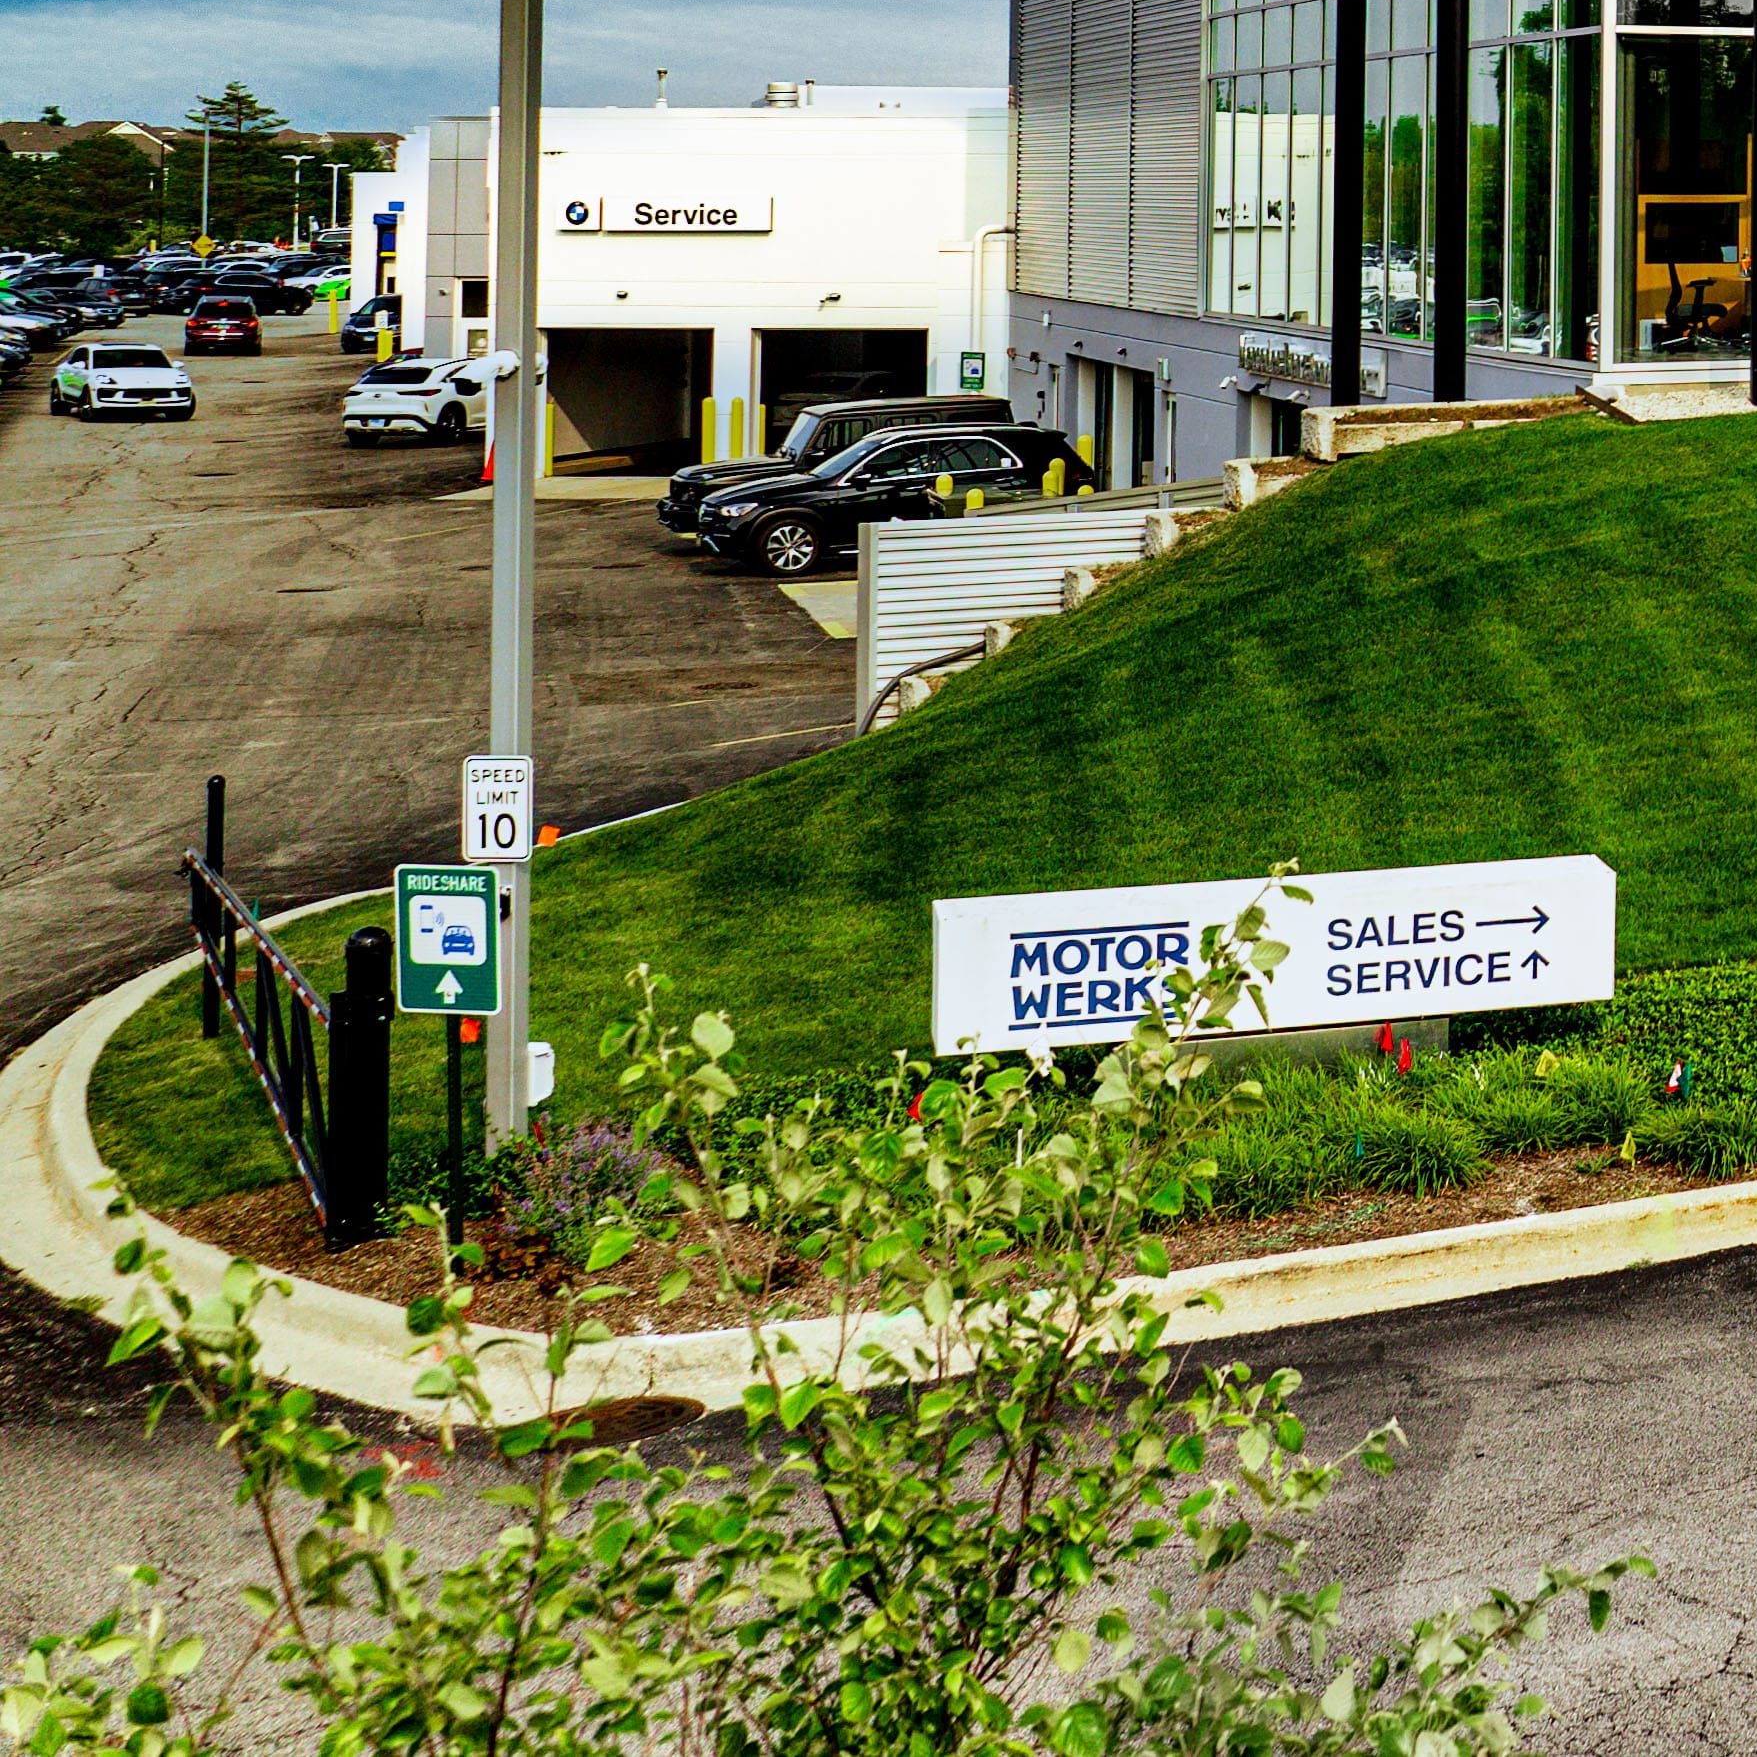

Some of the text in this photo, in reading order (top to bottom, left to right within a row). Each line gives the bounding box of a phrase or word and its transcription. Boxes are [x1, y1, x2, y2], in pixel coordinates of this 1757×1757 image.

[634, 203, 738, 225] Service
[471, 769, 525, 783] SPEED
[476, 791, 519, 804] LIMIT
[478, 813, 516, 849] 10
[407, 874, 487, 892] RIDESHARE
[1327, 910, 1465, 951] SALES
[1010, 933, 1190, 979] MOTOR
[1326, 951, 1511, 996] SERVICE
